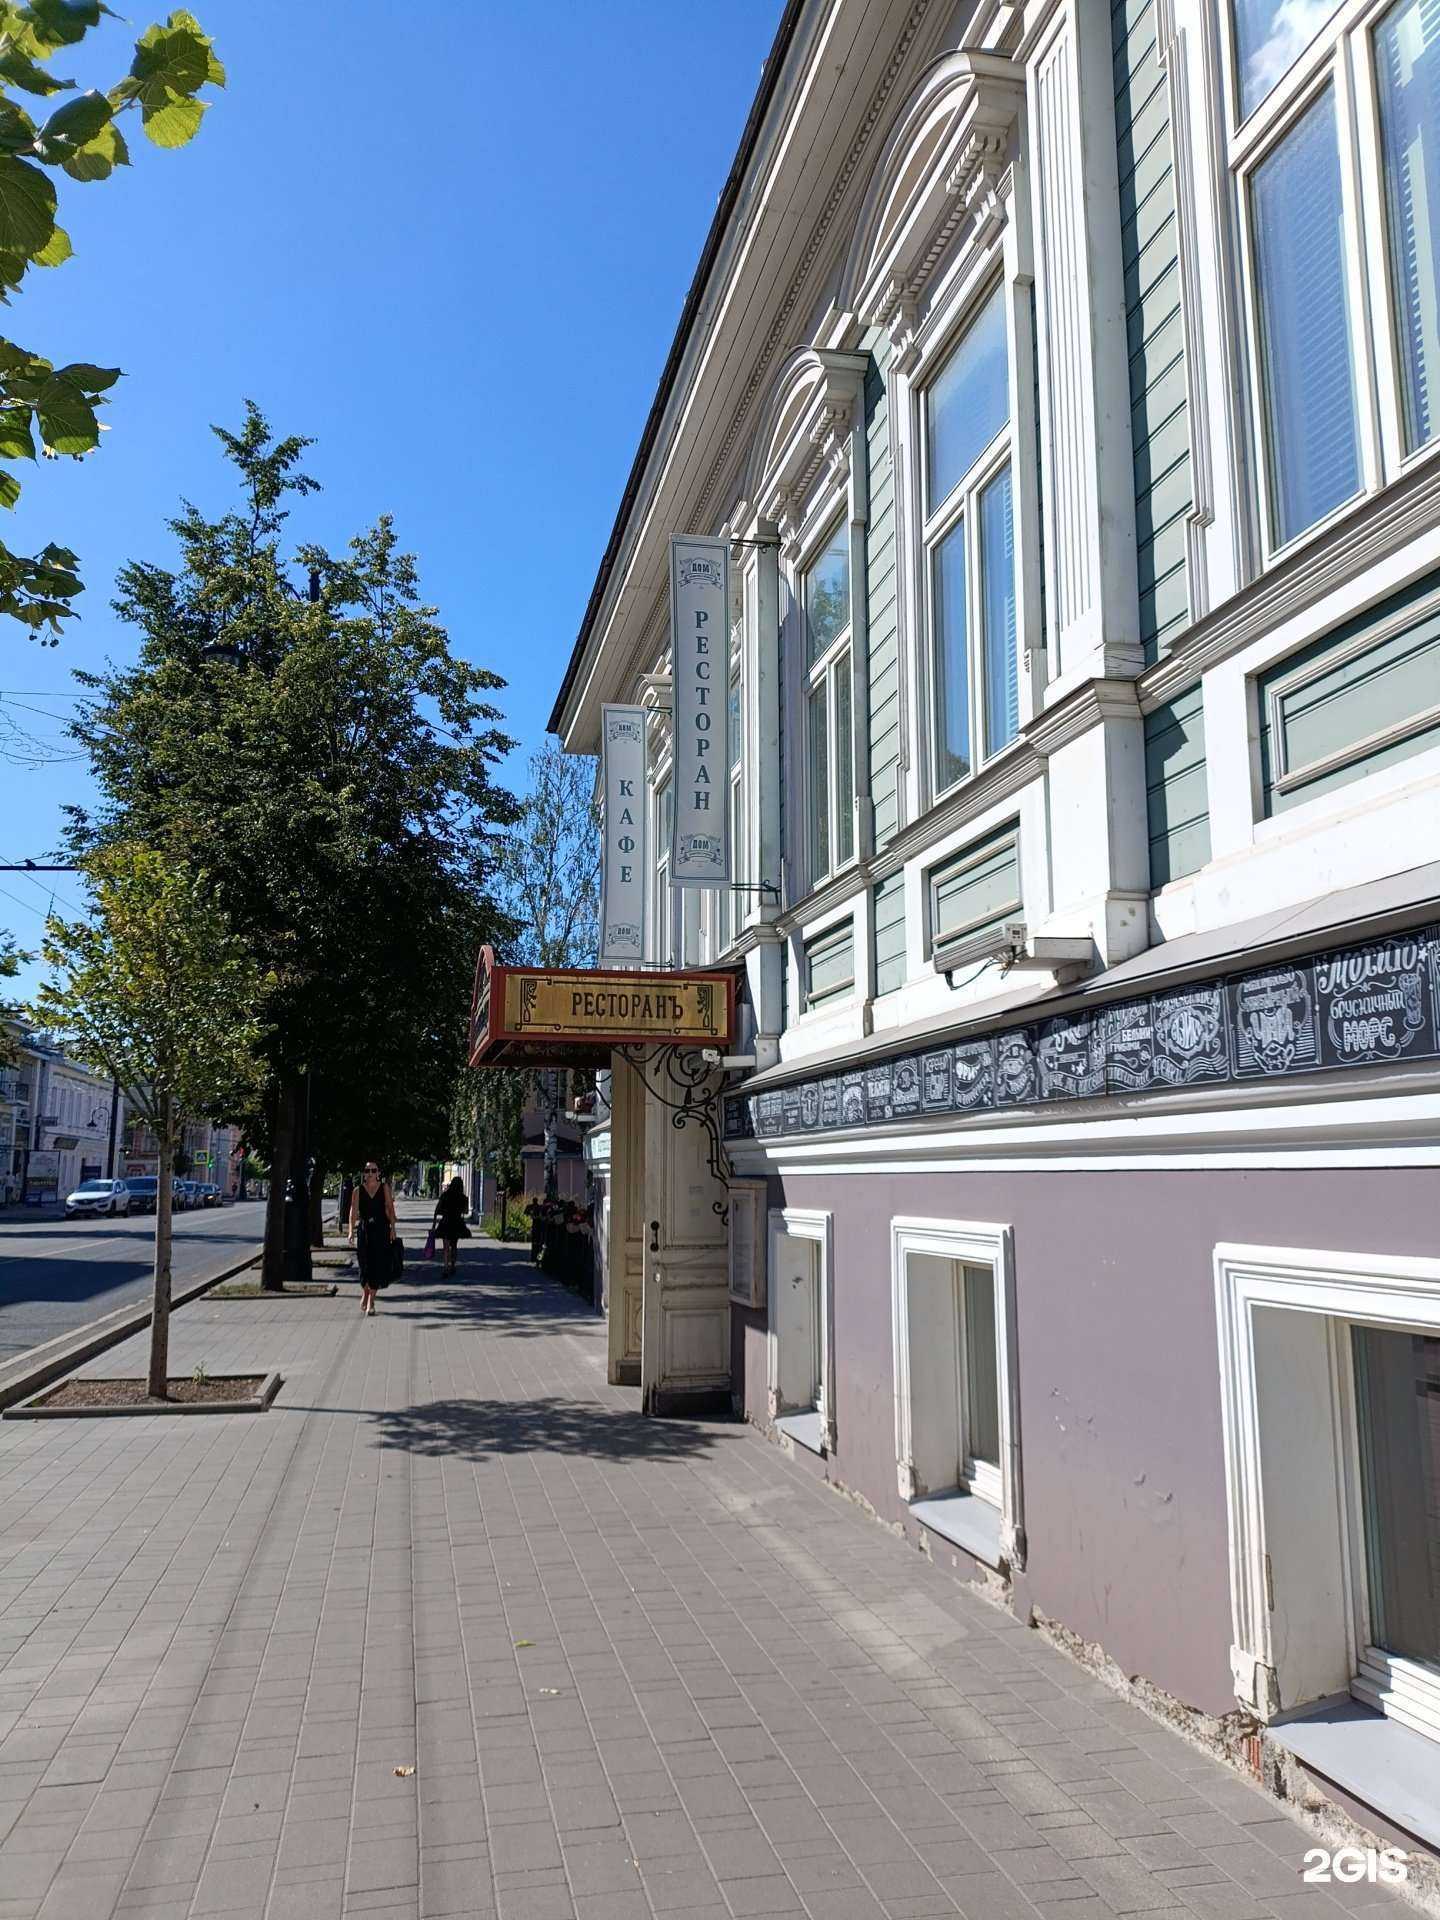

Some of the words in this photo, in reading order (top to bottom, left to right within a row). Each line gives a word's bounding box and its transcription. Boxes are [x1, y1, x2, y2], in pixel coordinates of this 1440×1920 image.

[694, 611, 710, 810] РЕСТОРАН
[618, 780, 635, 882] КАФЕ
[572, 992, 684, 1019] РЕСТОРАНЪ
[1343, 1016, 1396, 1052] МОРС
